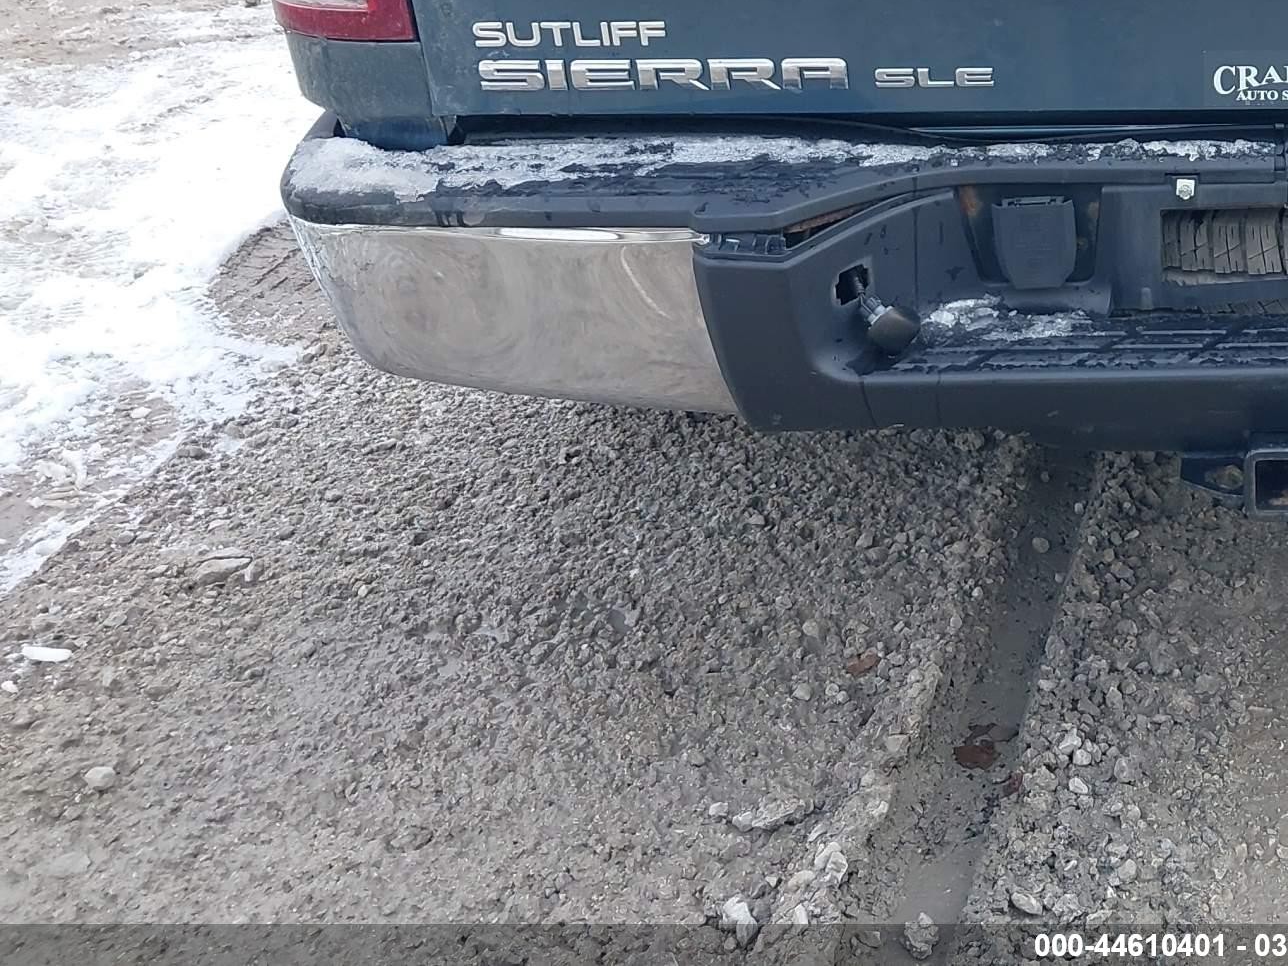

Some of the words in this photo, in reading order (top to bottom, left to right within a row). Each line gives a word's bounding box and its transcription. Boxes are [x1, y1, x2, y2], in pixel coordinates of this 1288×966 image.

[472, 20, 666, 47] SUTLIFF
[477, 58, 849, 91] SIERRA
[874, 67, 995, 88] SLE
[1236, 90, 1279, 101] AUTO
